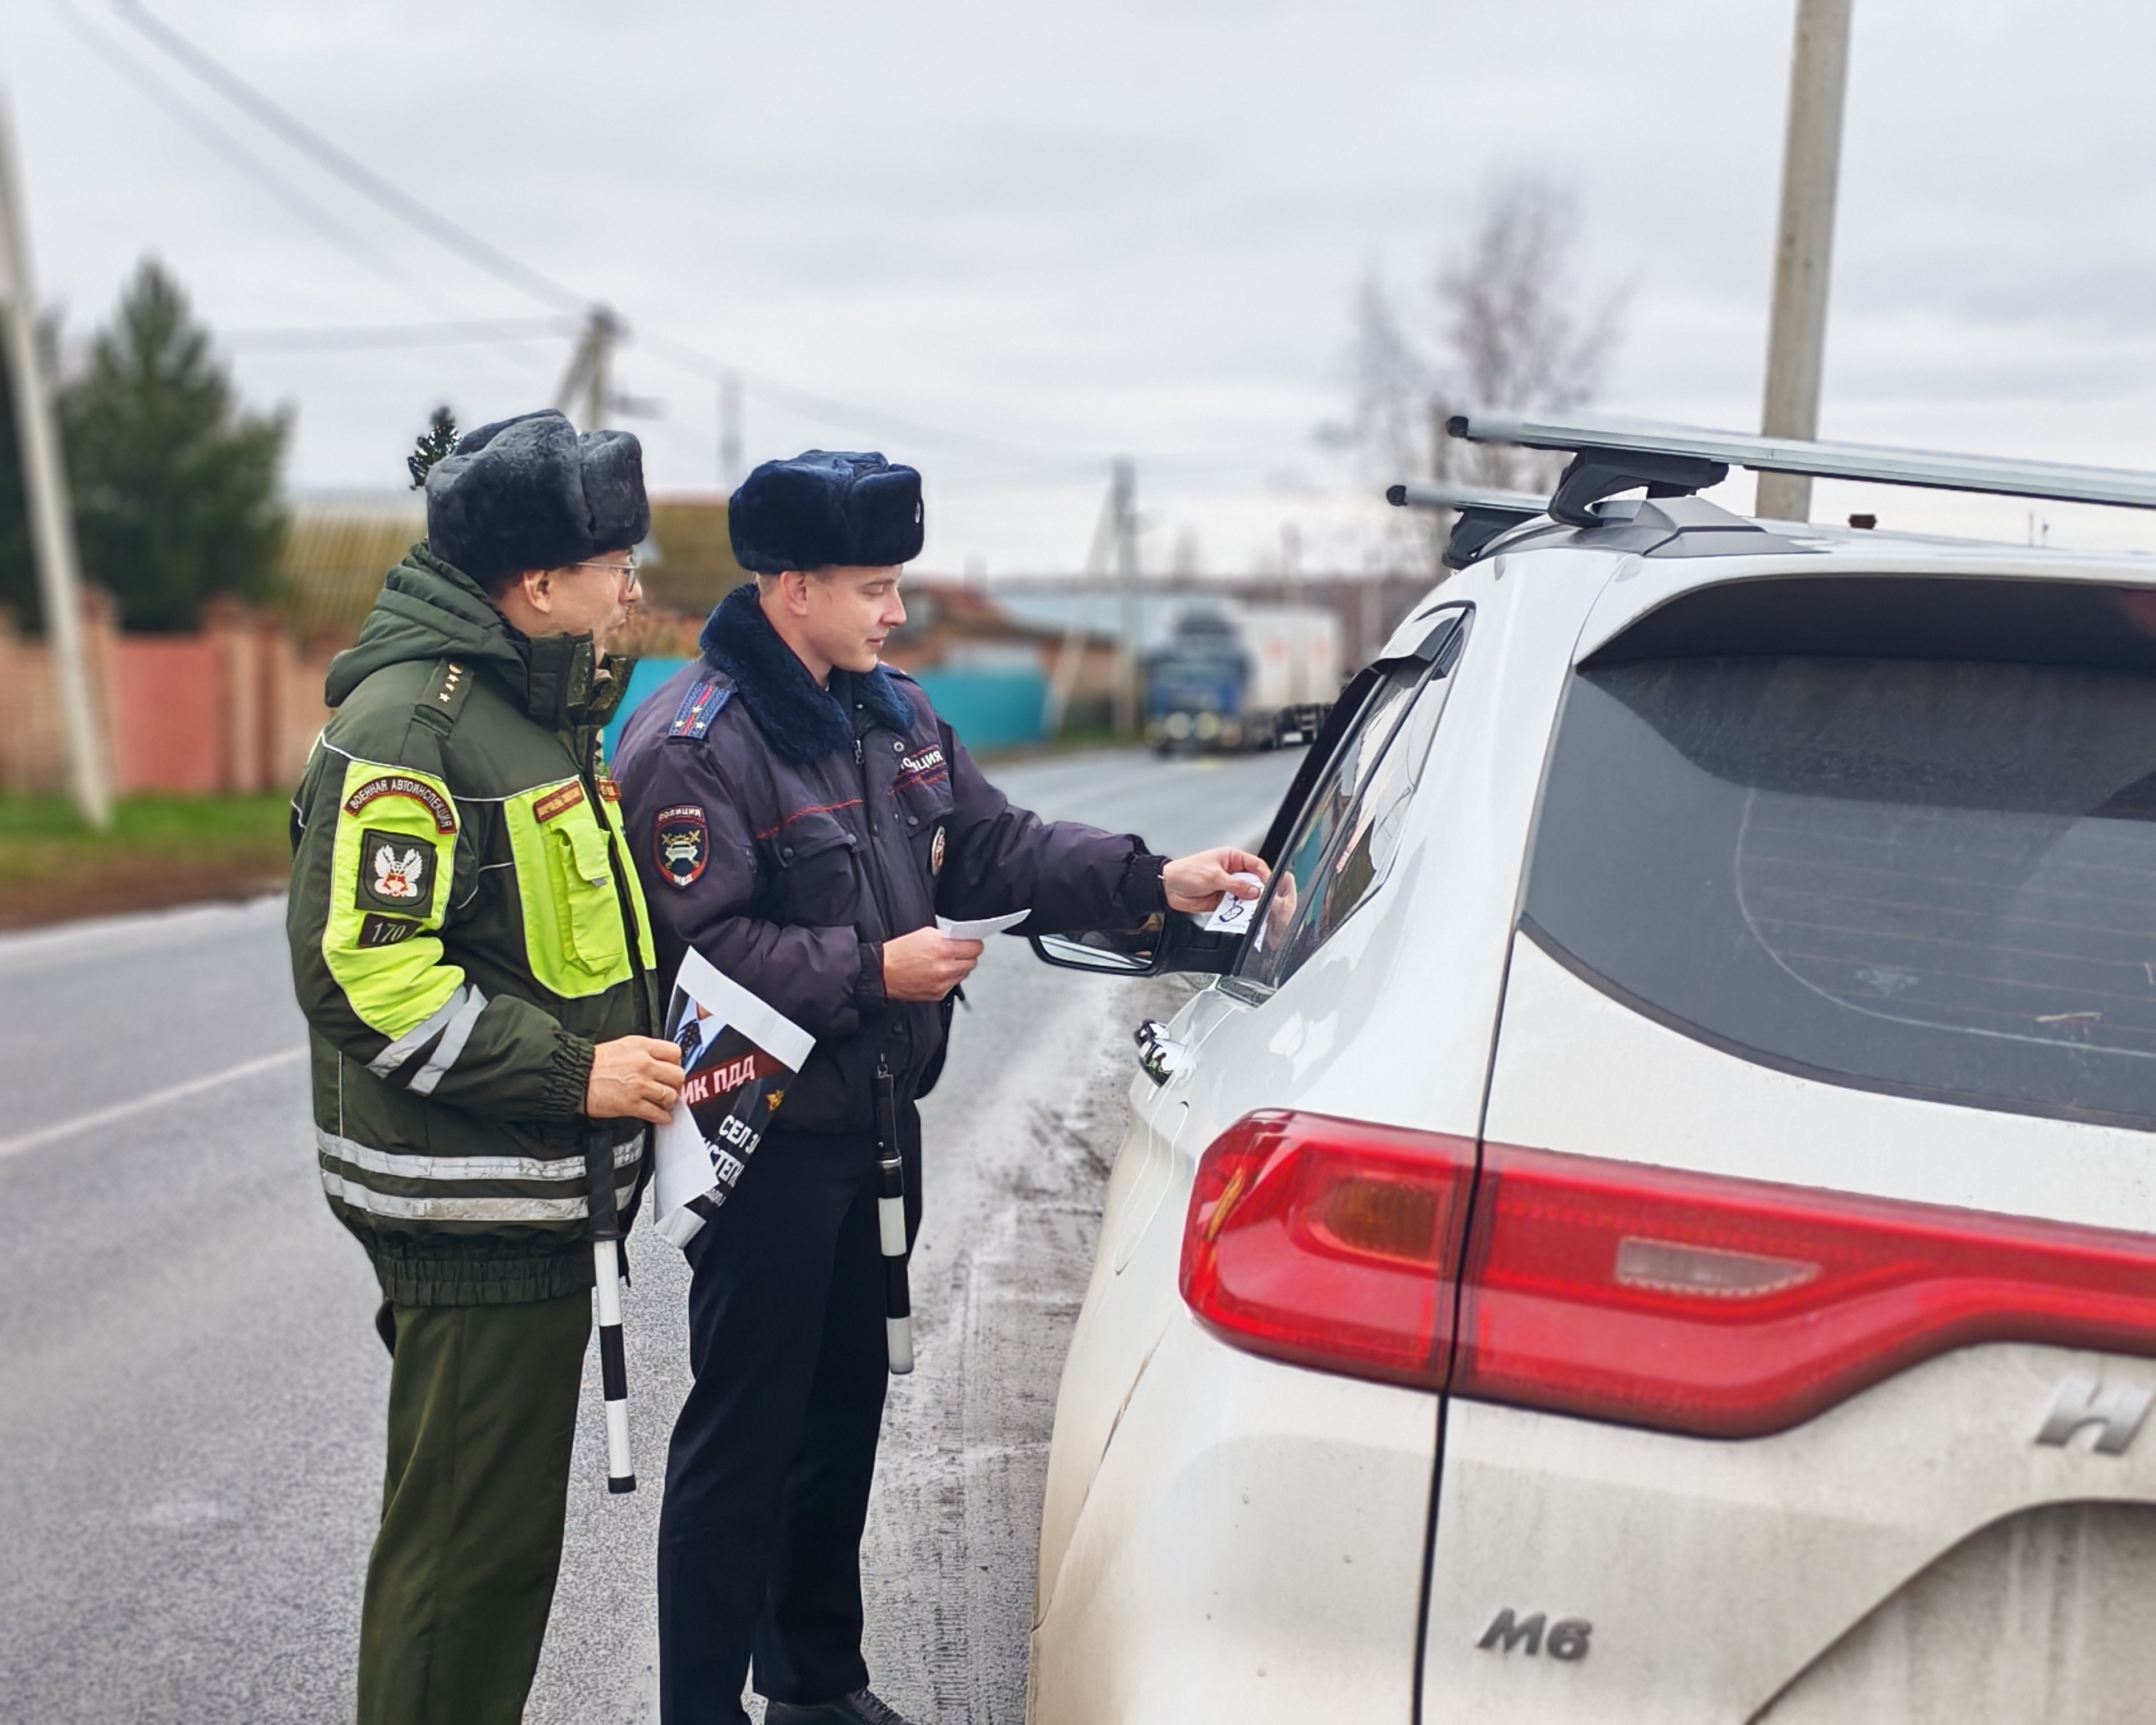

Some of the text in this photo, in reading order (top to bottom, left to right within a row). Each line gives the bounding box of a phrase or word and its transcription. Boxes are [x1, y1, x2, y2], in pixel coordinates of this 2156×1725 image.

[350, 778, 453, 828] ВОЕННАЯ АВТОИНСПЕКЦИЯ
[372, 921, 406, 942] 170
[713, 1055, 755, 1094] ПДД
[719, 1115, 752, 1148] СЕЛ
[1476, 1607, 1593, 1662] M6
